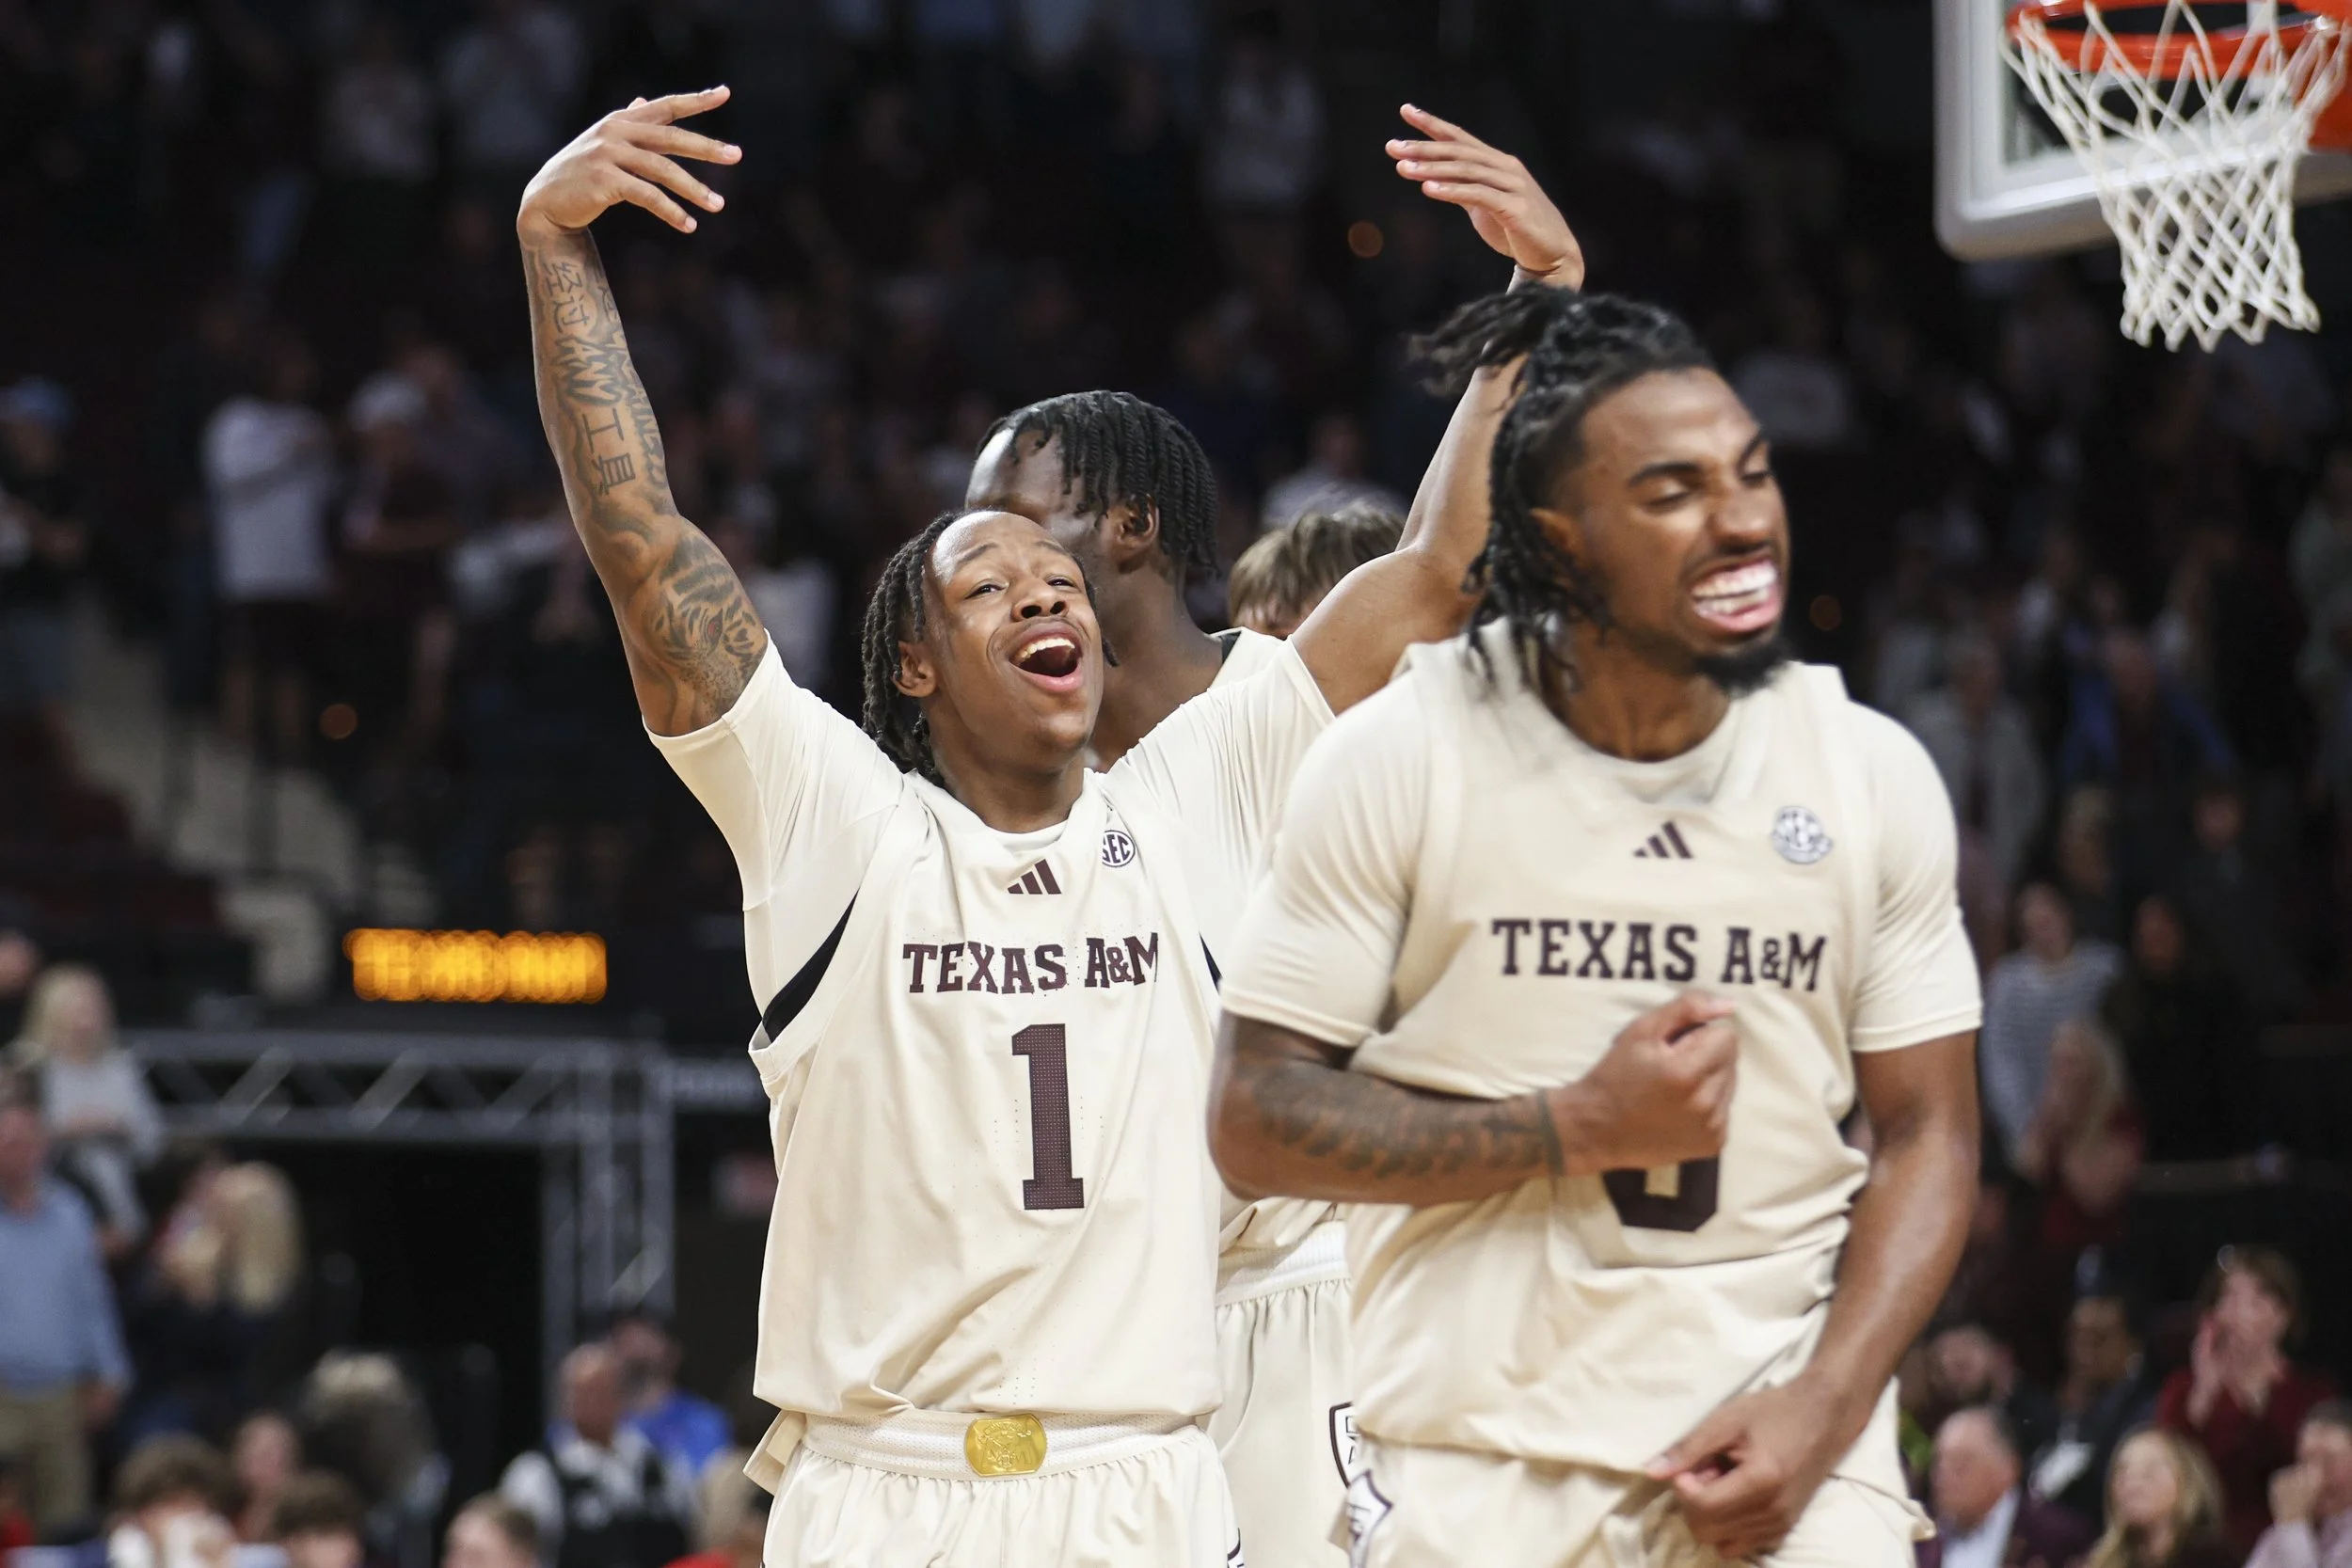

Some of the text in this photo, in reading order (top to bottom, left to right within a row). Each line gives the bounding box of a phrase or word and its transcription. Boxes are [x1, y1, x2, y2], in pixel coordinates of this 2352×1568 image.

[1102, 833, 1131, 863] SEC
[902, 932, 1159, 995] TEXAS A&M
[1492, 918, 1828, 992] TEXAS A&M
[1011, 1023, 1085, 1211] 1
